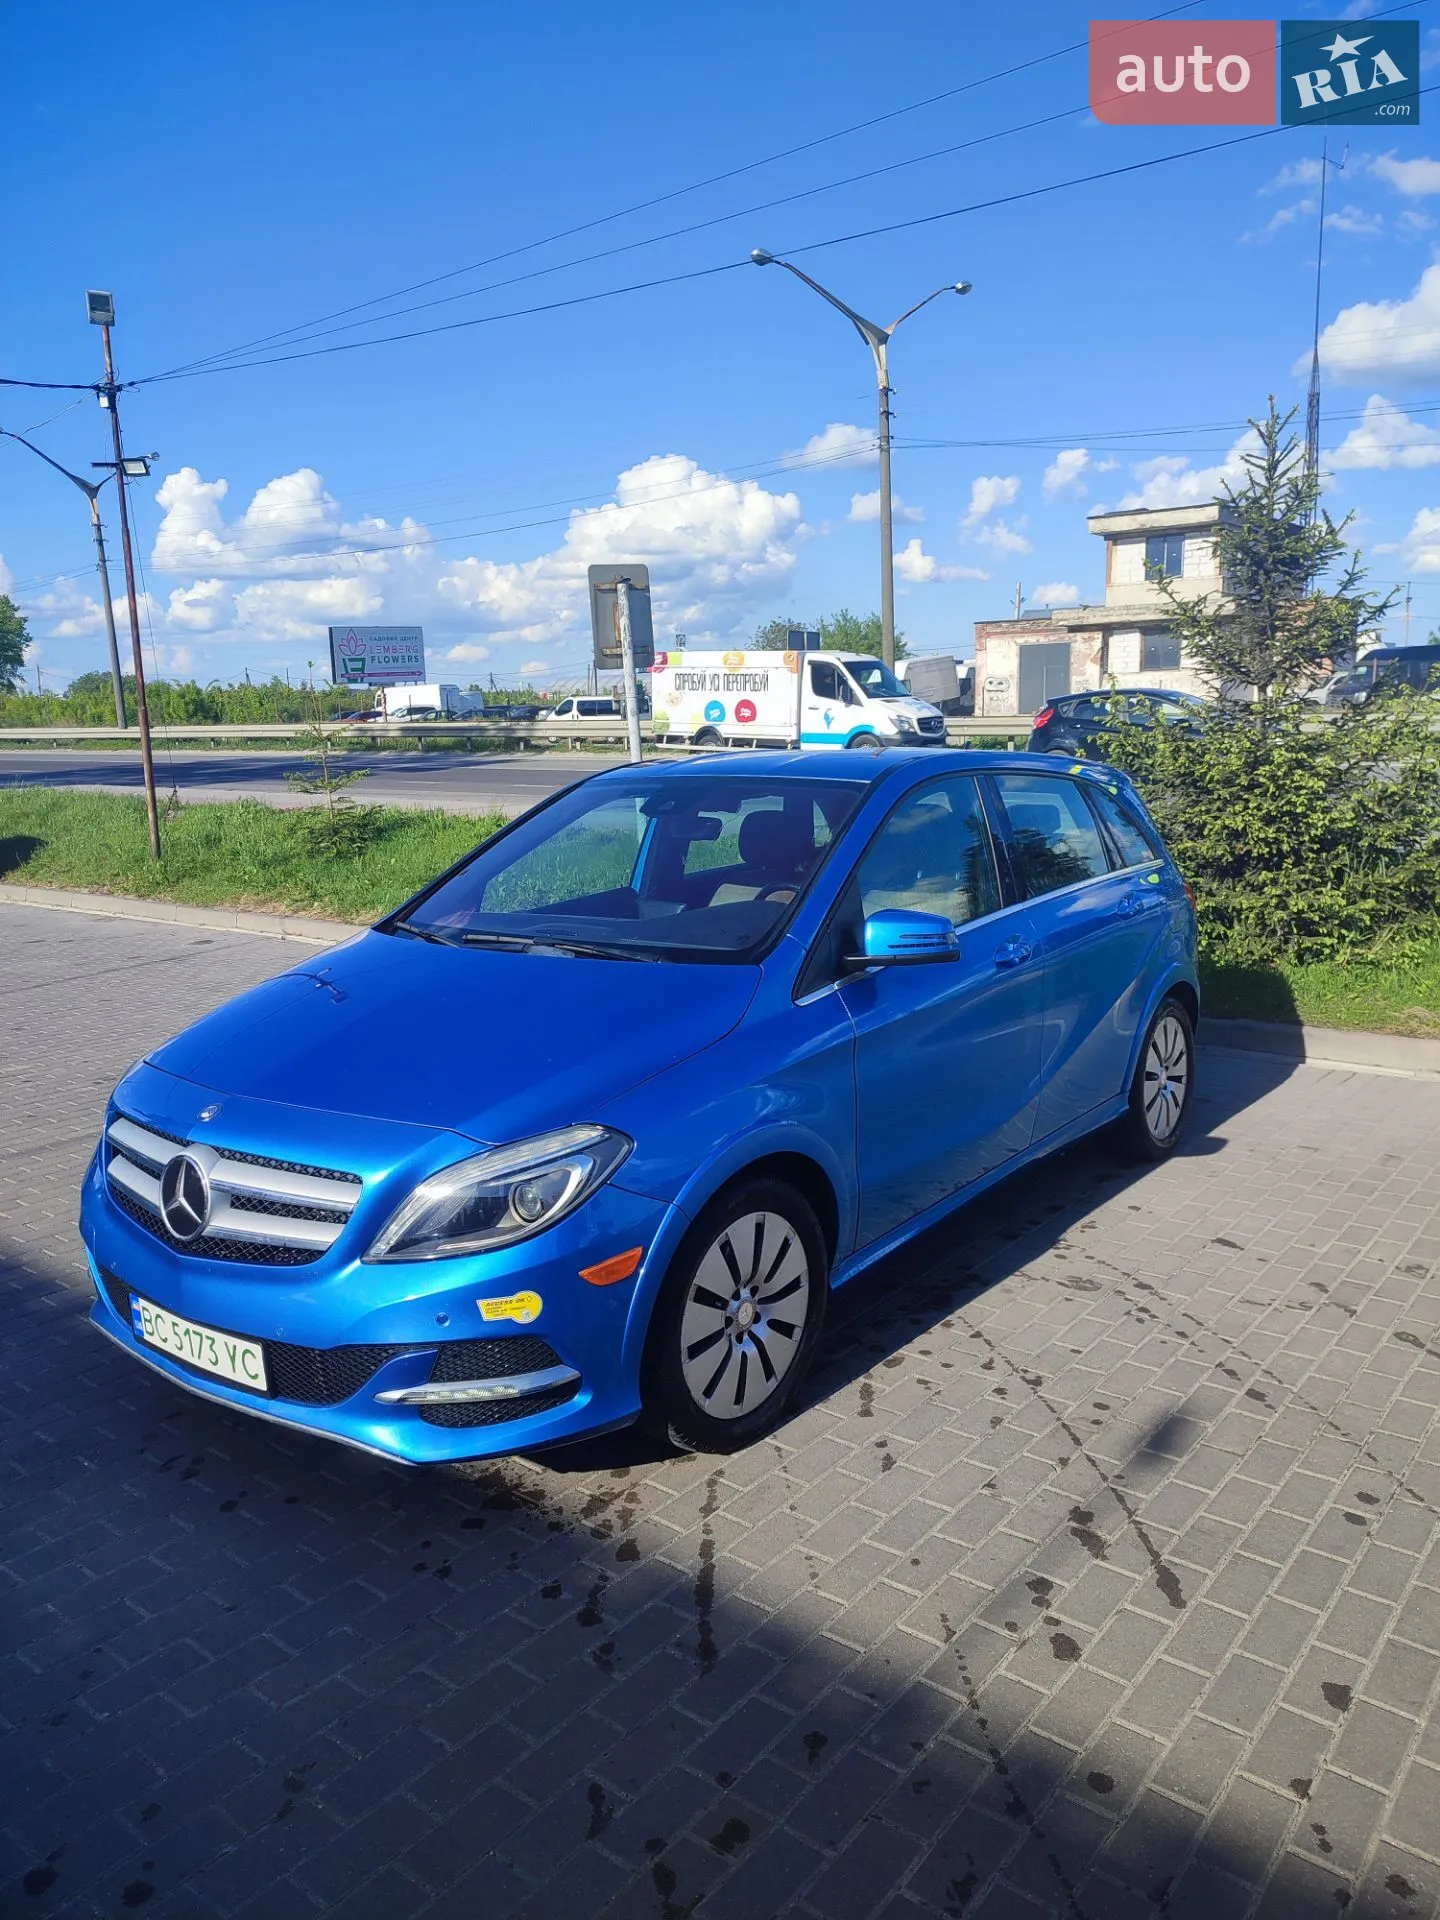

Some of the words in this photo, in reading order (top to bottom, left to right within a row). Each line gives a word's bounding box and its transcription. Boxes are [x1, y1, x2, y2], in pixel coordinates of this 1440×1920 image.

[370, 645, 419, 654] LEMBERG
[370, 655, 420, 664] FLOWERS
[674, 670, 706, 692] СПРОБУЙ
[723, 670, 769, 692] ПЕРЕПРОБУЙ
[142, 1306, 168, 1344] BC
[171, 1320, 219, 1367] 5173
